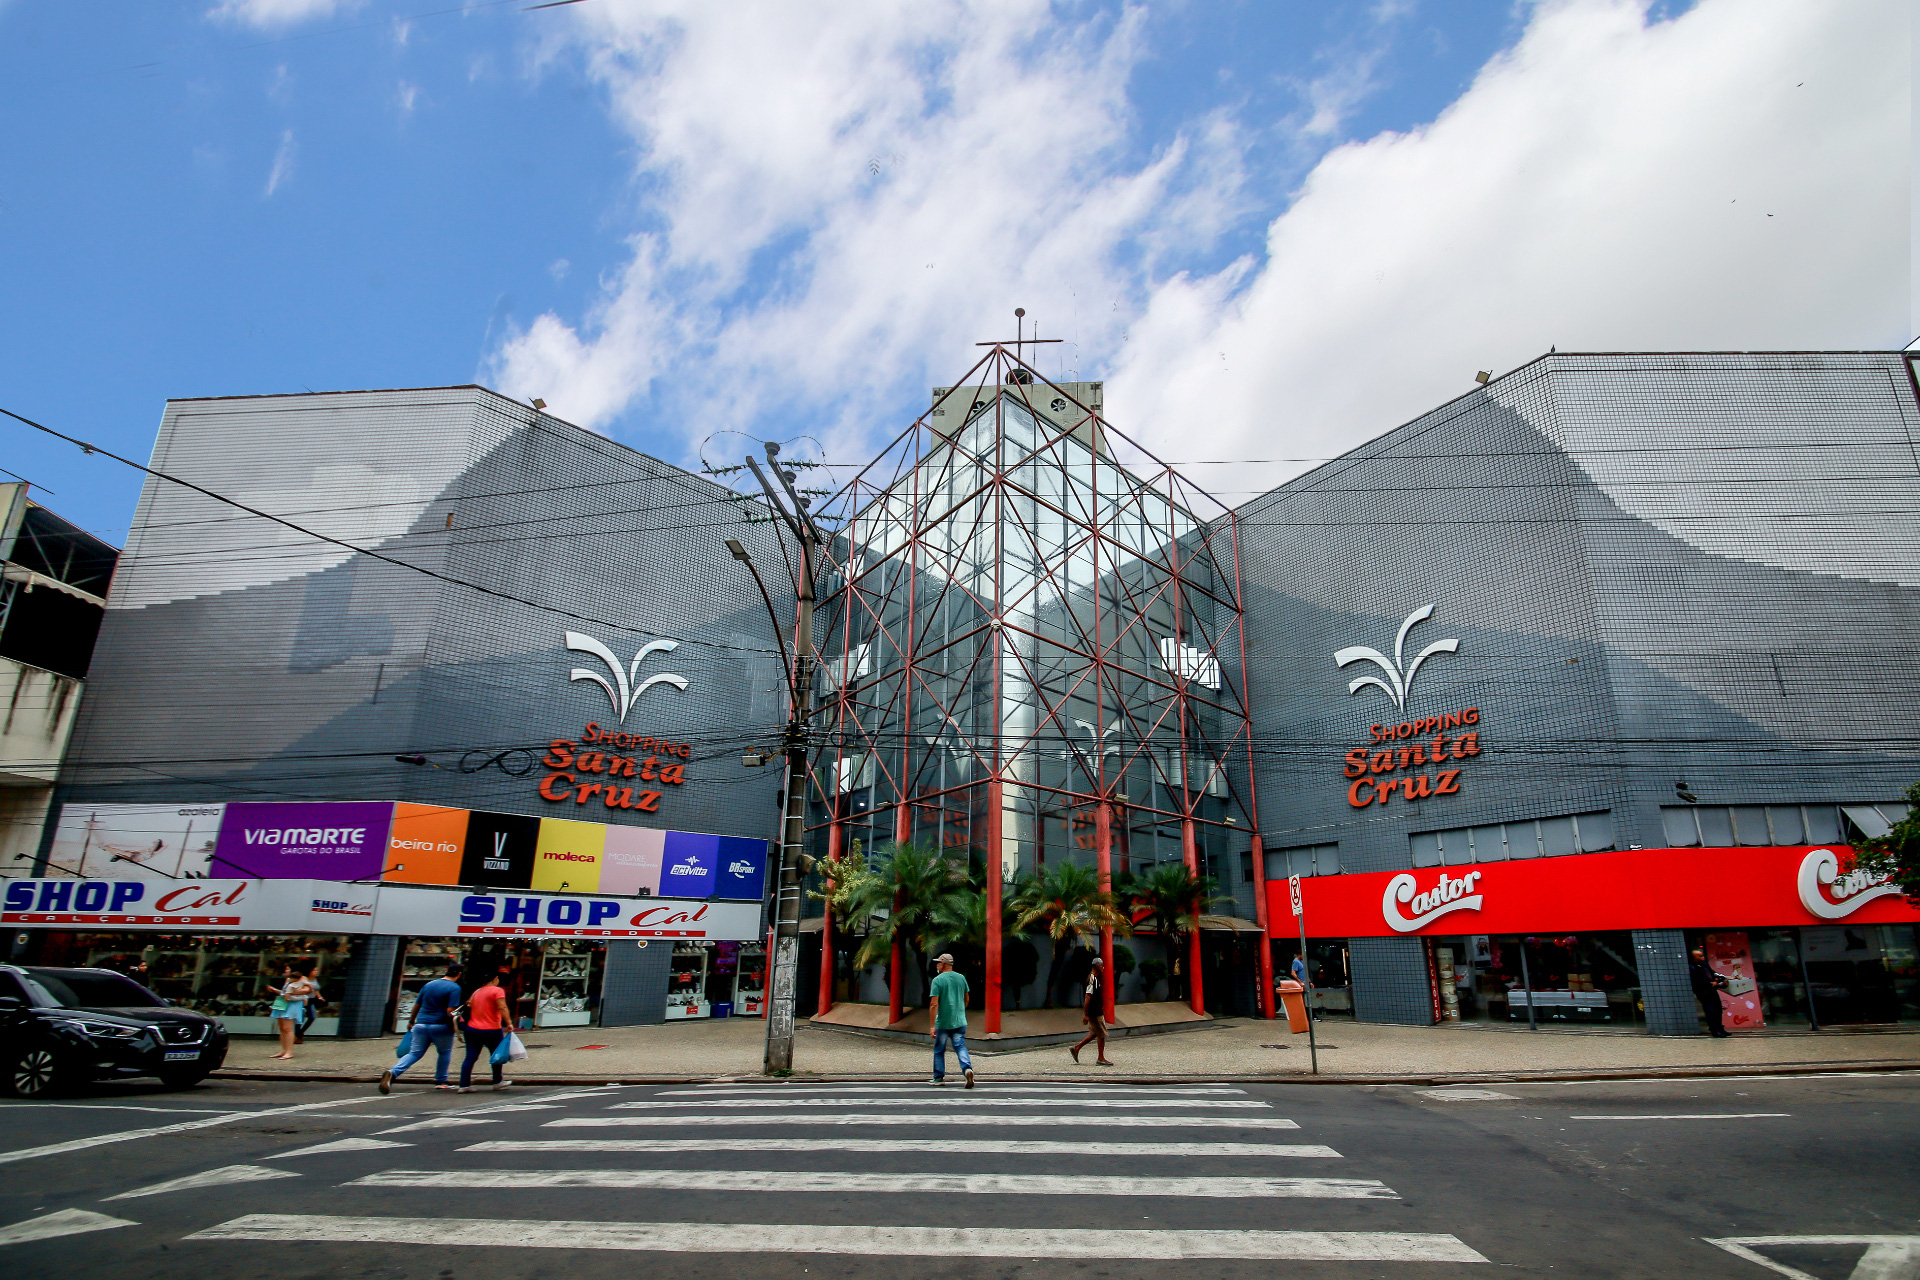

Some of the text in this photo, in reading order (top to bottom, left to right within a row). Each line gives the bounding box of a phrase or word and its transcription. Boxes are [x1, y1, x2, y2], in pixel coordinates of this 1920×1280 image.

[582, 722, 691, 758] SHOPPING
[1369, 707, 1478, 744] SHOPPING
[542, 739, 686, 785] Santa
[1343, 732, 1481, 777] Santa
[539, 771, 662, 812] Cruz
[1347, 769, 1460, 807] Cruz
[280, 847, 317, 855] GAROTAS
[391, 836, 458, 853] beira rio
[543, 850, 596, 863] moleca
[3, 881, 248, 913] SHOP Cal
[311, 899, 374, 911] SHOP Cal
[459, 895, 709, 927] SHOP Cal
[1382, 870, 1484, 933] Castor
[19, 914, 219, 924] CALÇADOS
